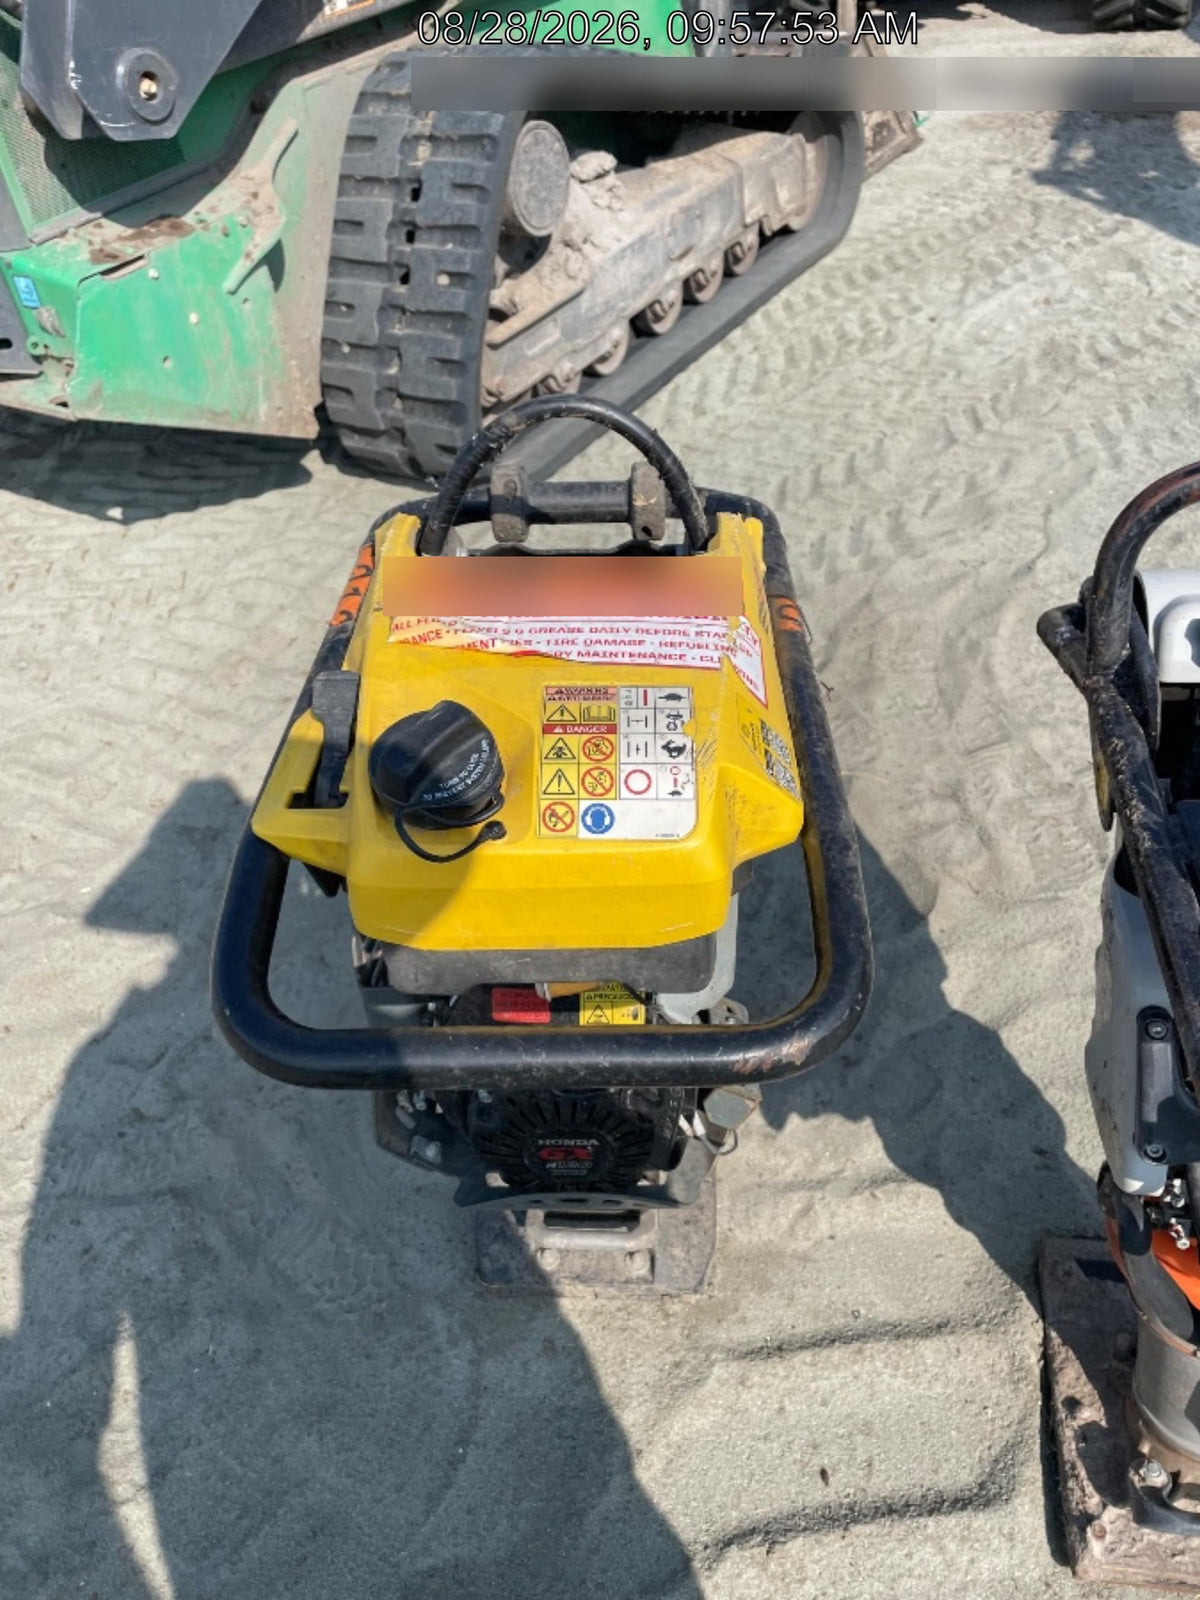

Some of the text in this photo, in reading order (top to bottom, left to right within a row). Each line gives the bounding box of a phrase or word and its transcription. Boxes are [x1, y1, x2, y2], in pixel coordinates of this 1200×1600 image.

[528, 626, 585, 634] GREASE
[589, 626, 632, 635] DAILY
[635, 627, 691, 637] BEFORE
[546, 638, 580, 646] TIRE
[583, 638, 647, 647] DAMAGE
[659, 640, 738, 658] REFUELING
[577, 649, 687, 661] MAINTENANCE
[566, 725, 608, 734] DANGER
[537, 1138, 601, 1146] HONDA
